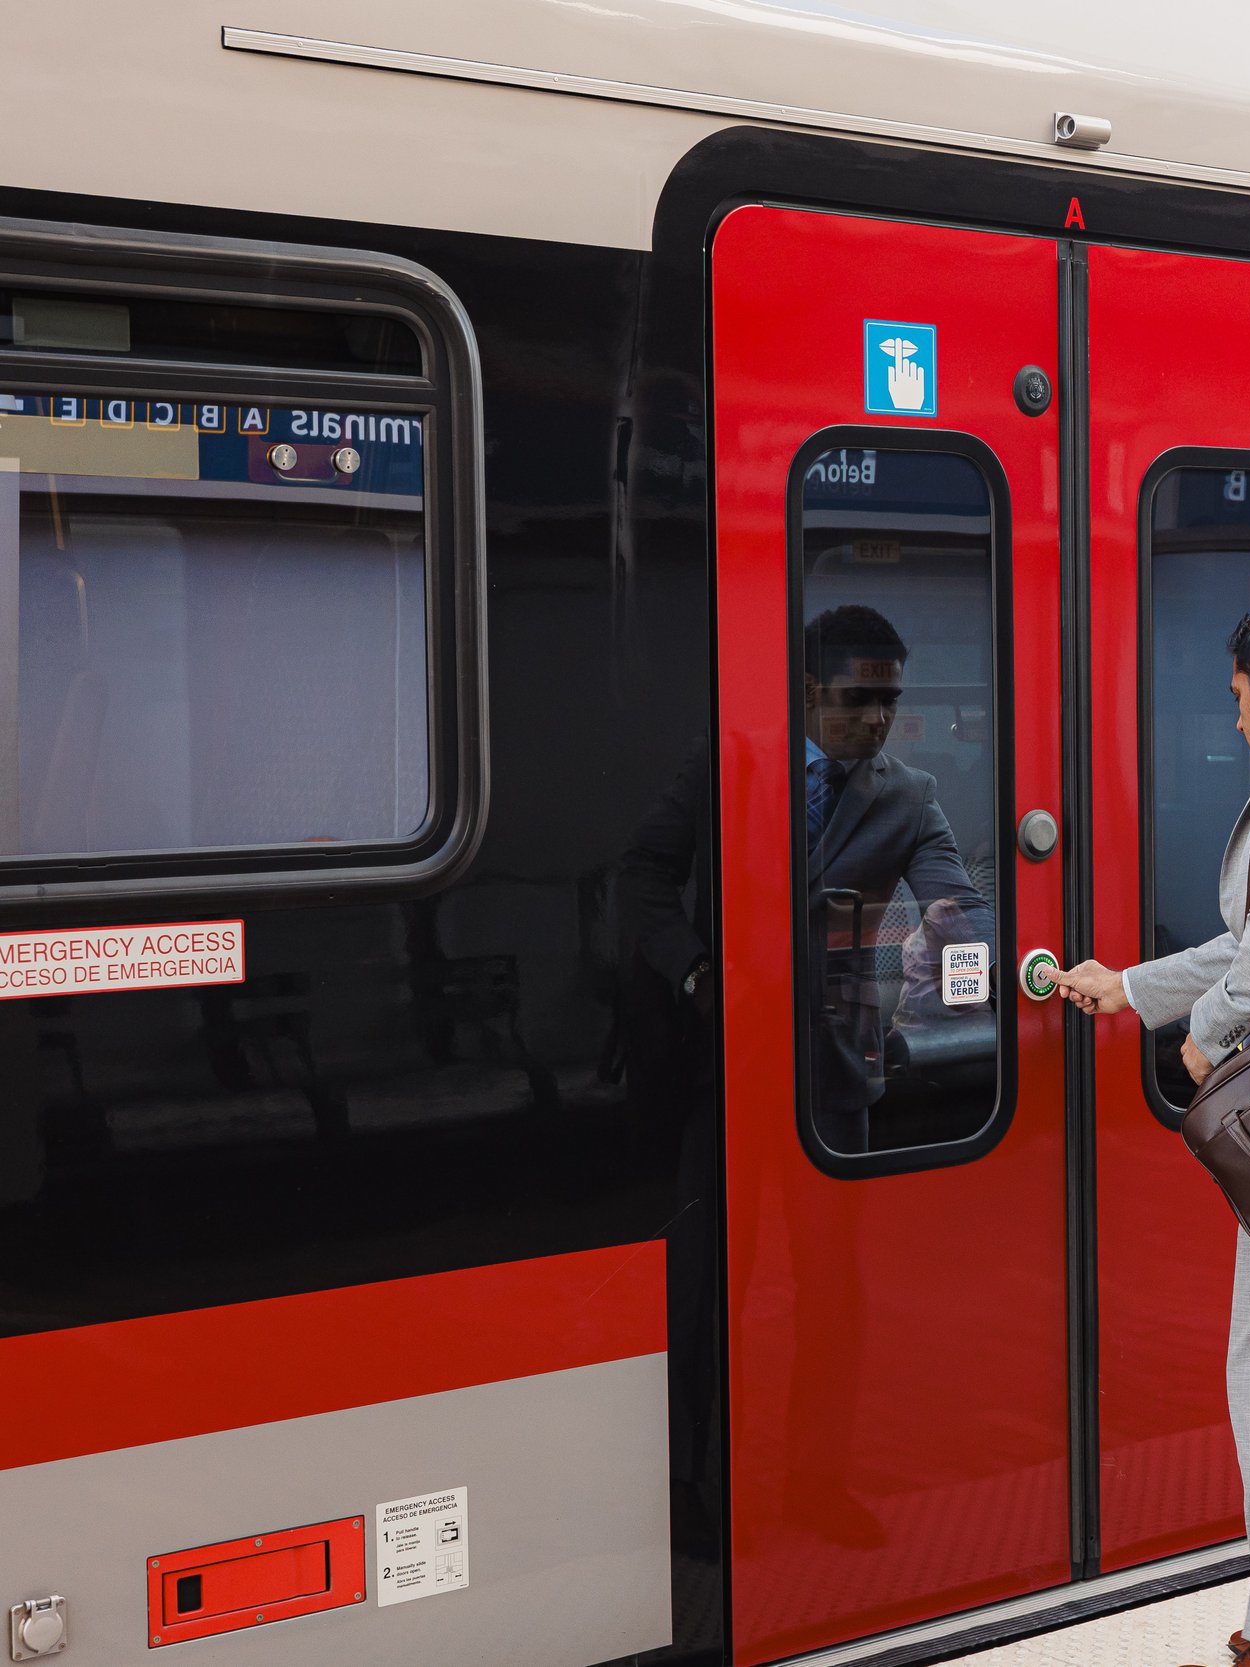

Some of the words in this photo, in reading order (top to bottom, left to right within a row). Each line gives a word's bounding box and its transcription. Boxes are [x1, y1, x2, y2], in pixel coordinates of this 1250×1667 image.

[1064, 196, 1086, 230] A
[860, 543, 893, 559] EXIT
[141, 931, 236, 956] ACCESS
[950, 953, 979, 962] GREEN
[74, 965, 101, 983] DE
[107, 956, 236, 981] EMERGENCIA
[950, 987, 979, 996] VERDE
[382, 1512, 408, 1523] ACCESO
[418, 1502, 458, 1516] EMERGENCIA
[385, 1500, 427, 1515] EMERGENCY
[428, 1494, 455, 1506] ACCESS
[383, 1531, 394, 1543] 1.
[383, 1567, 395, 1579] 2.
